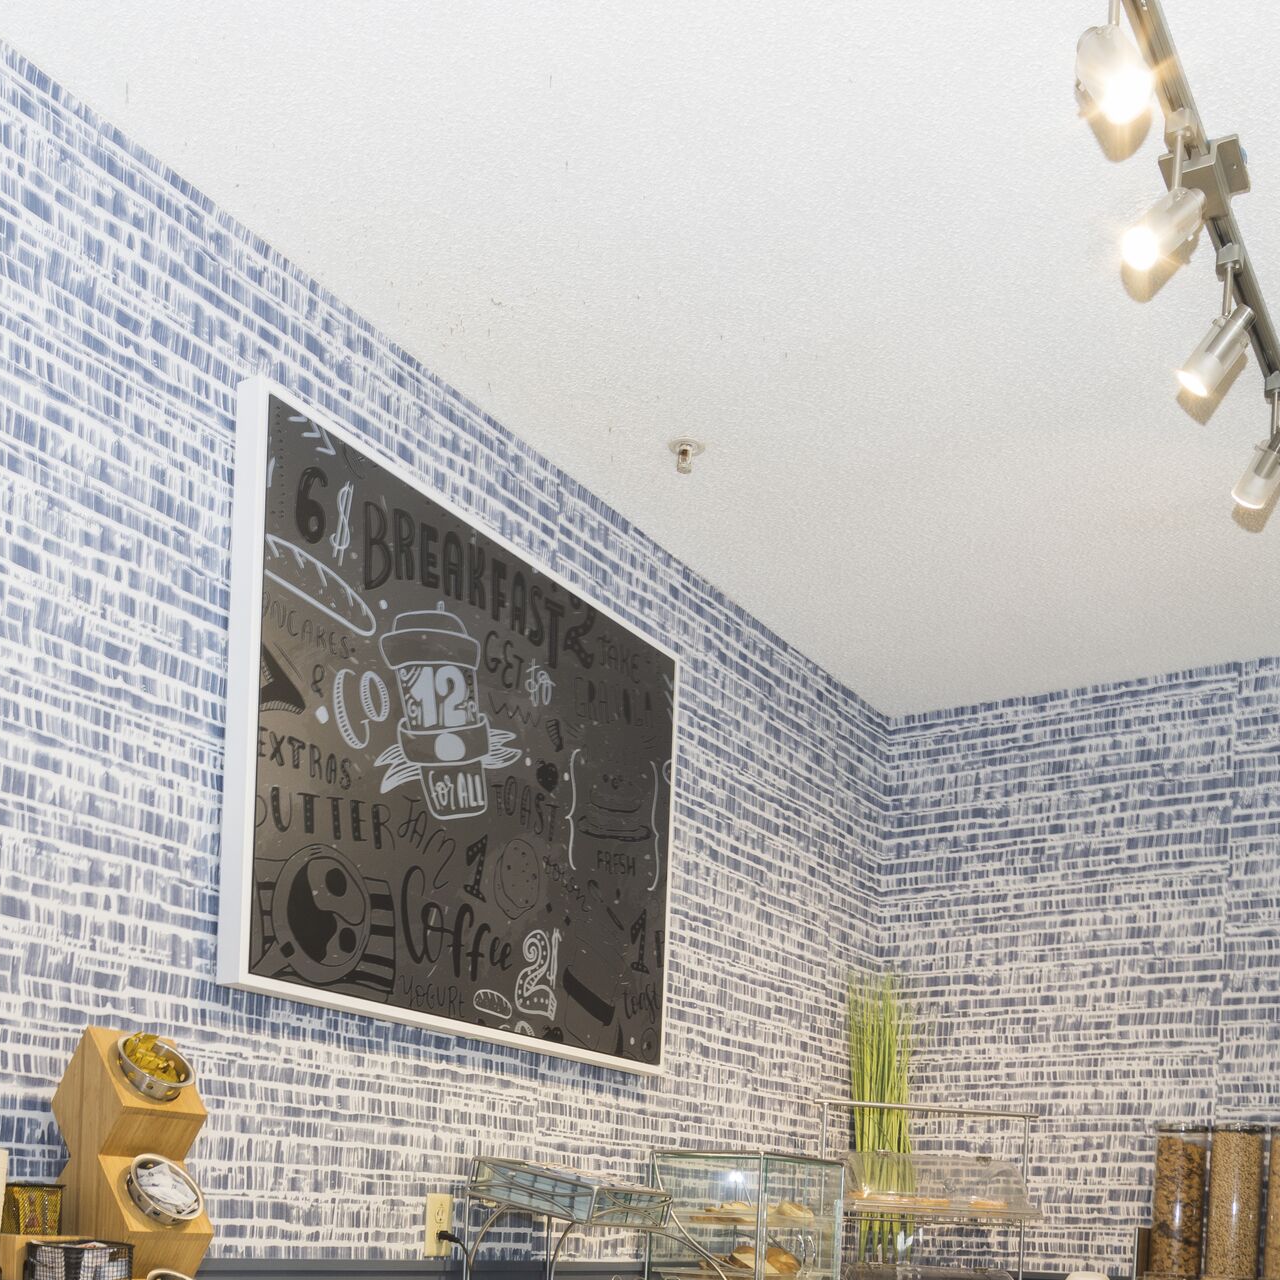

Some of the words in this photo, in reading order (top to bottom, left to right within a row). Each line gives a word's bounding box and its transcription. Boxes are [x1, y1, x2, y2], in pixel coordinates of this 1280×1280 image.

[364, 501, 565, 669] BREAKFAST
[490, 775, 560, 841] TOAST
[400, 865, 513, 982] Coffee
